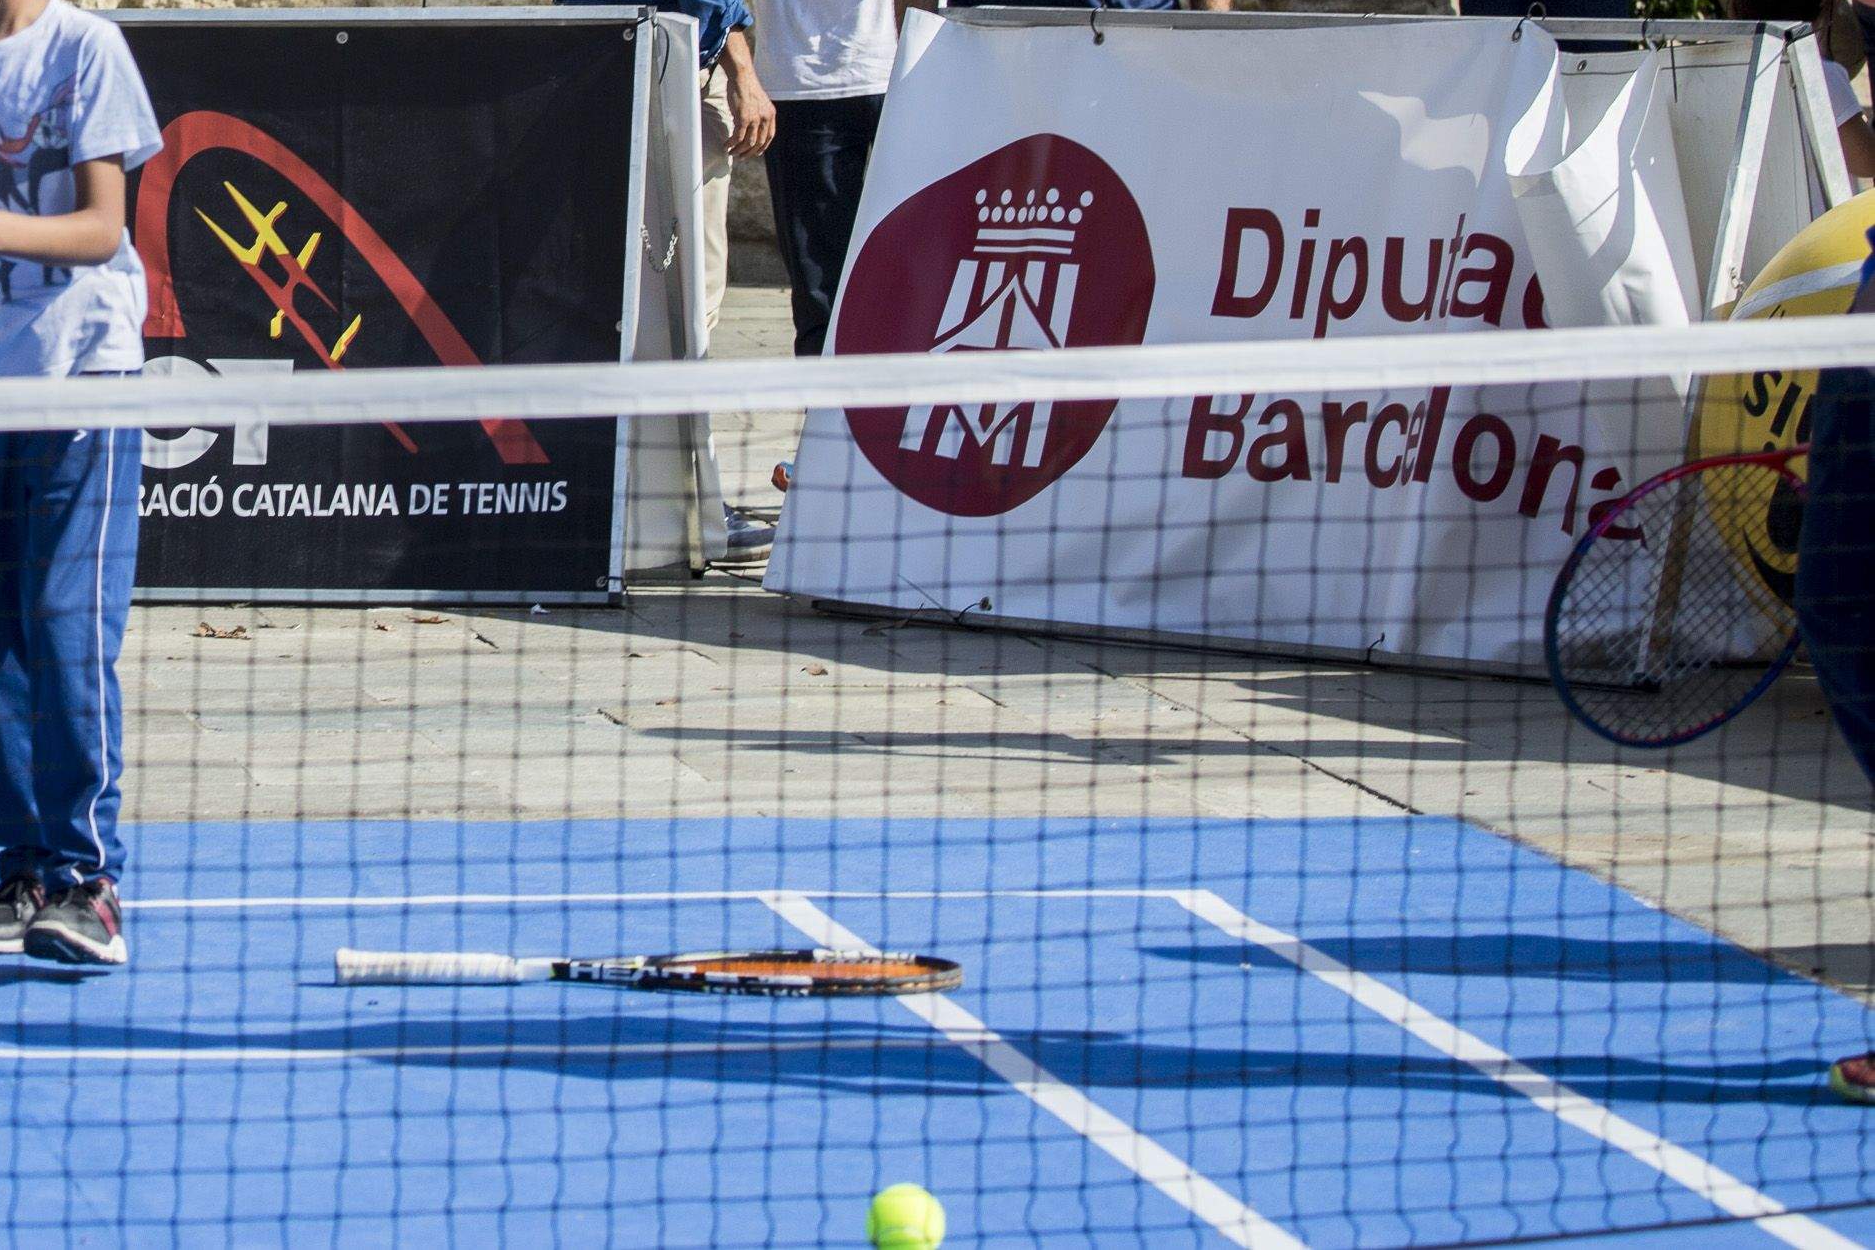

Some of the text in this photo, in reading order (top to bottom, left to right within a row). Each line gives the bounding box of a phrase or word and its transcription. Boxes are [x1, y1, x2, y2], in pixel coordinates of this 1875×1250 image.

[232, 482, 400, 518] CATALANA
[408, 483, 451, 516] DE
[458, 480, 568, 515] TENNIS
